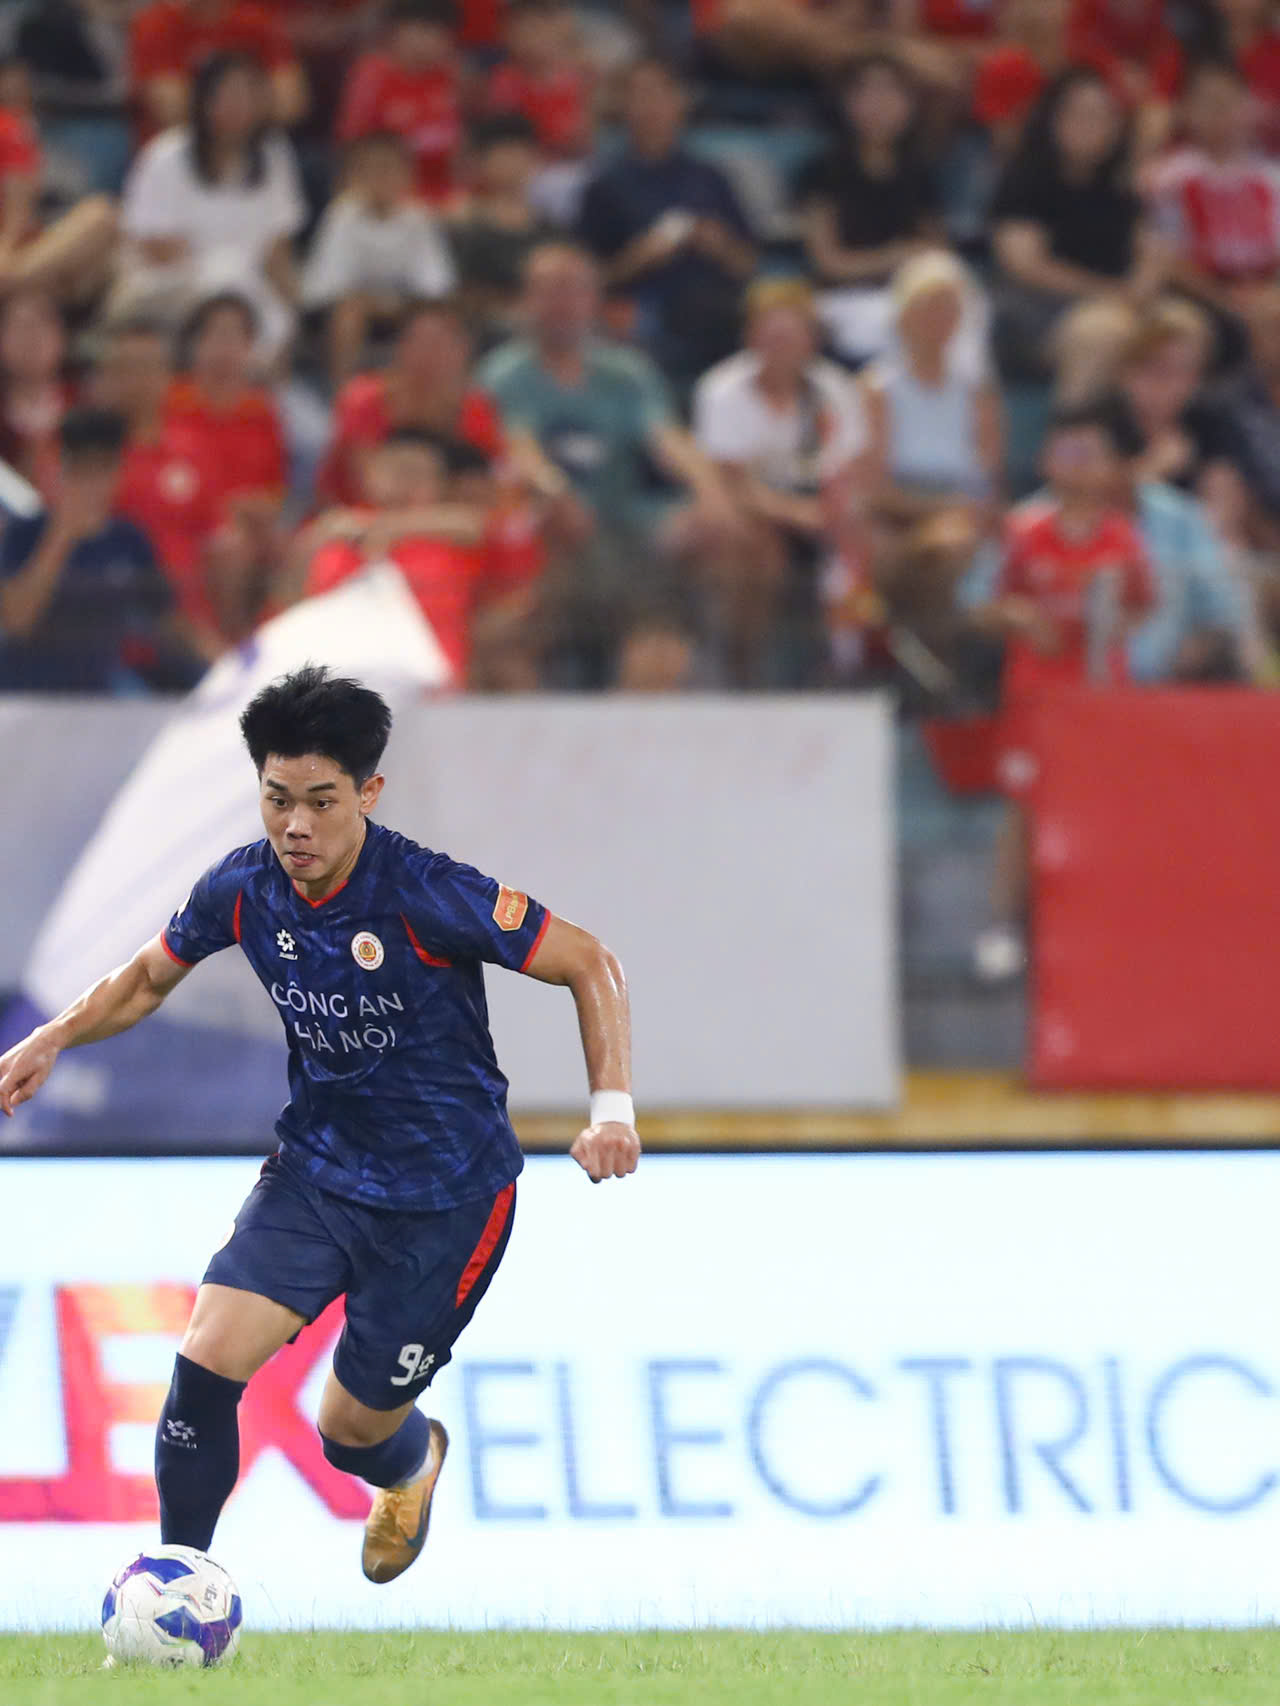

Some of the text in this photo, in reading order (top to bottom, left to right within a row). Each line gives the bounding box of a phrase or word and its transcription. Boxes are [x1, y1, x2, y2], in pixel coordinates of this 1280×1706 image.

[271, 981, 404, 1018] CÔNG AN
[339, 1023, 396, 1053] NỘI
[458, 1352, 1280, 1522] ELECTRIC
